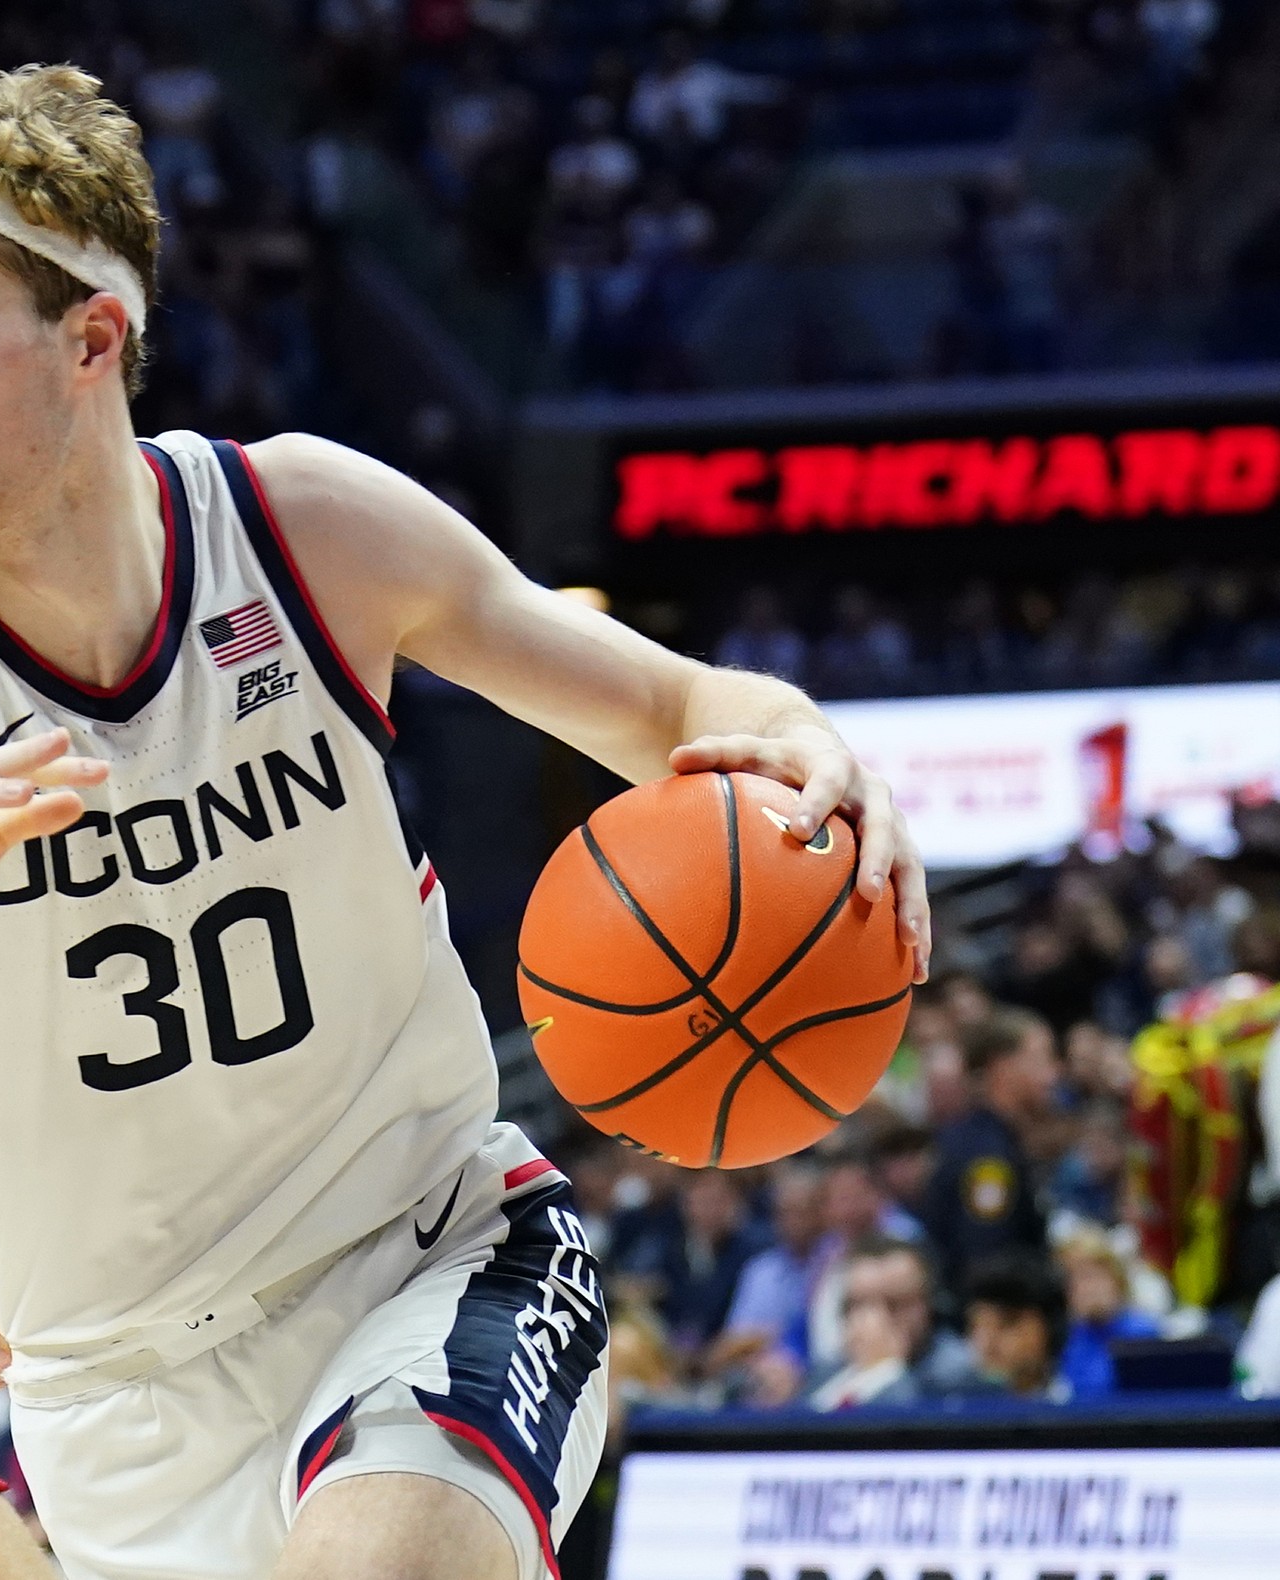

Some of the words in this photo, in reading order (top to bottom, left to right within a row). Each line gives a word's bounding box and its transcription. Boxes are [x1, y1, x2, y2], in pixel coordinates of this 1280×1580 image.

[773, 424, 1280, 534] RICHARD
[237, 671, 299, 712] EAST
[238, 659, 282, 694] BIG
[65, 886, 315, 1092] 30
[503, 1205, 600, 1455] HUSKIES
